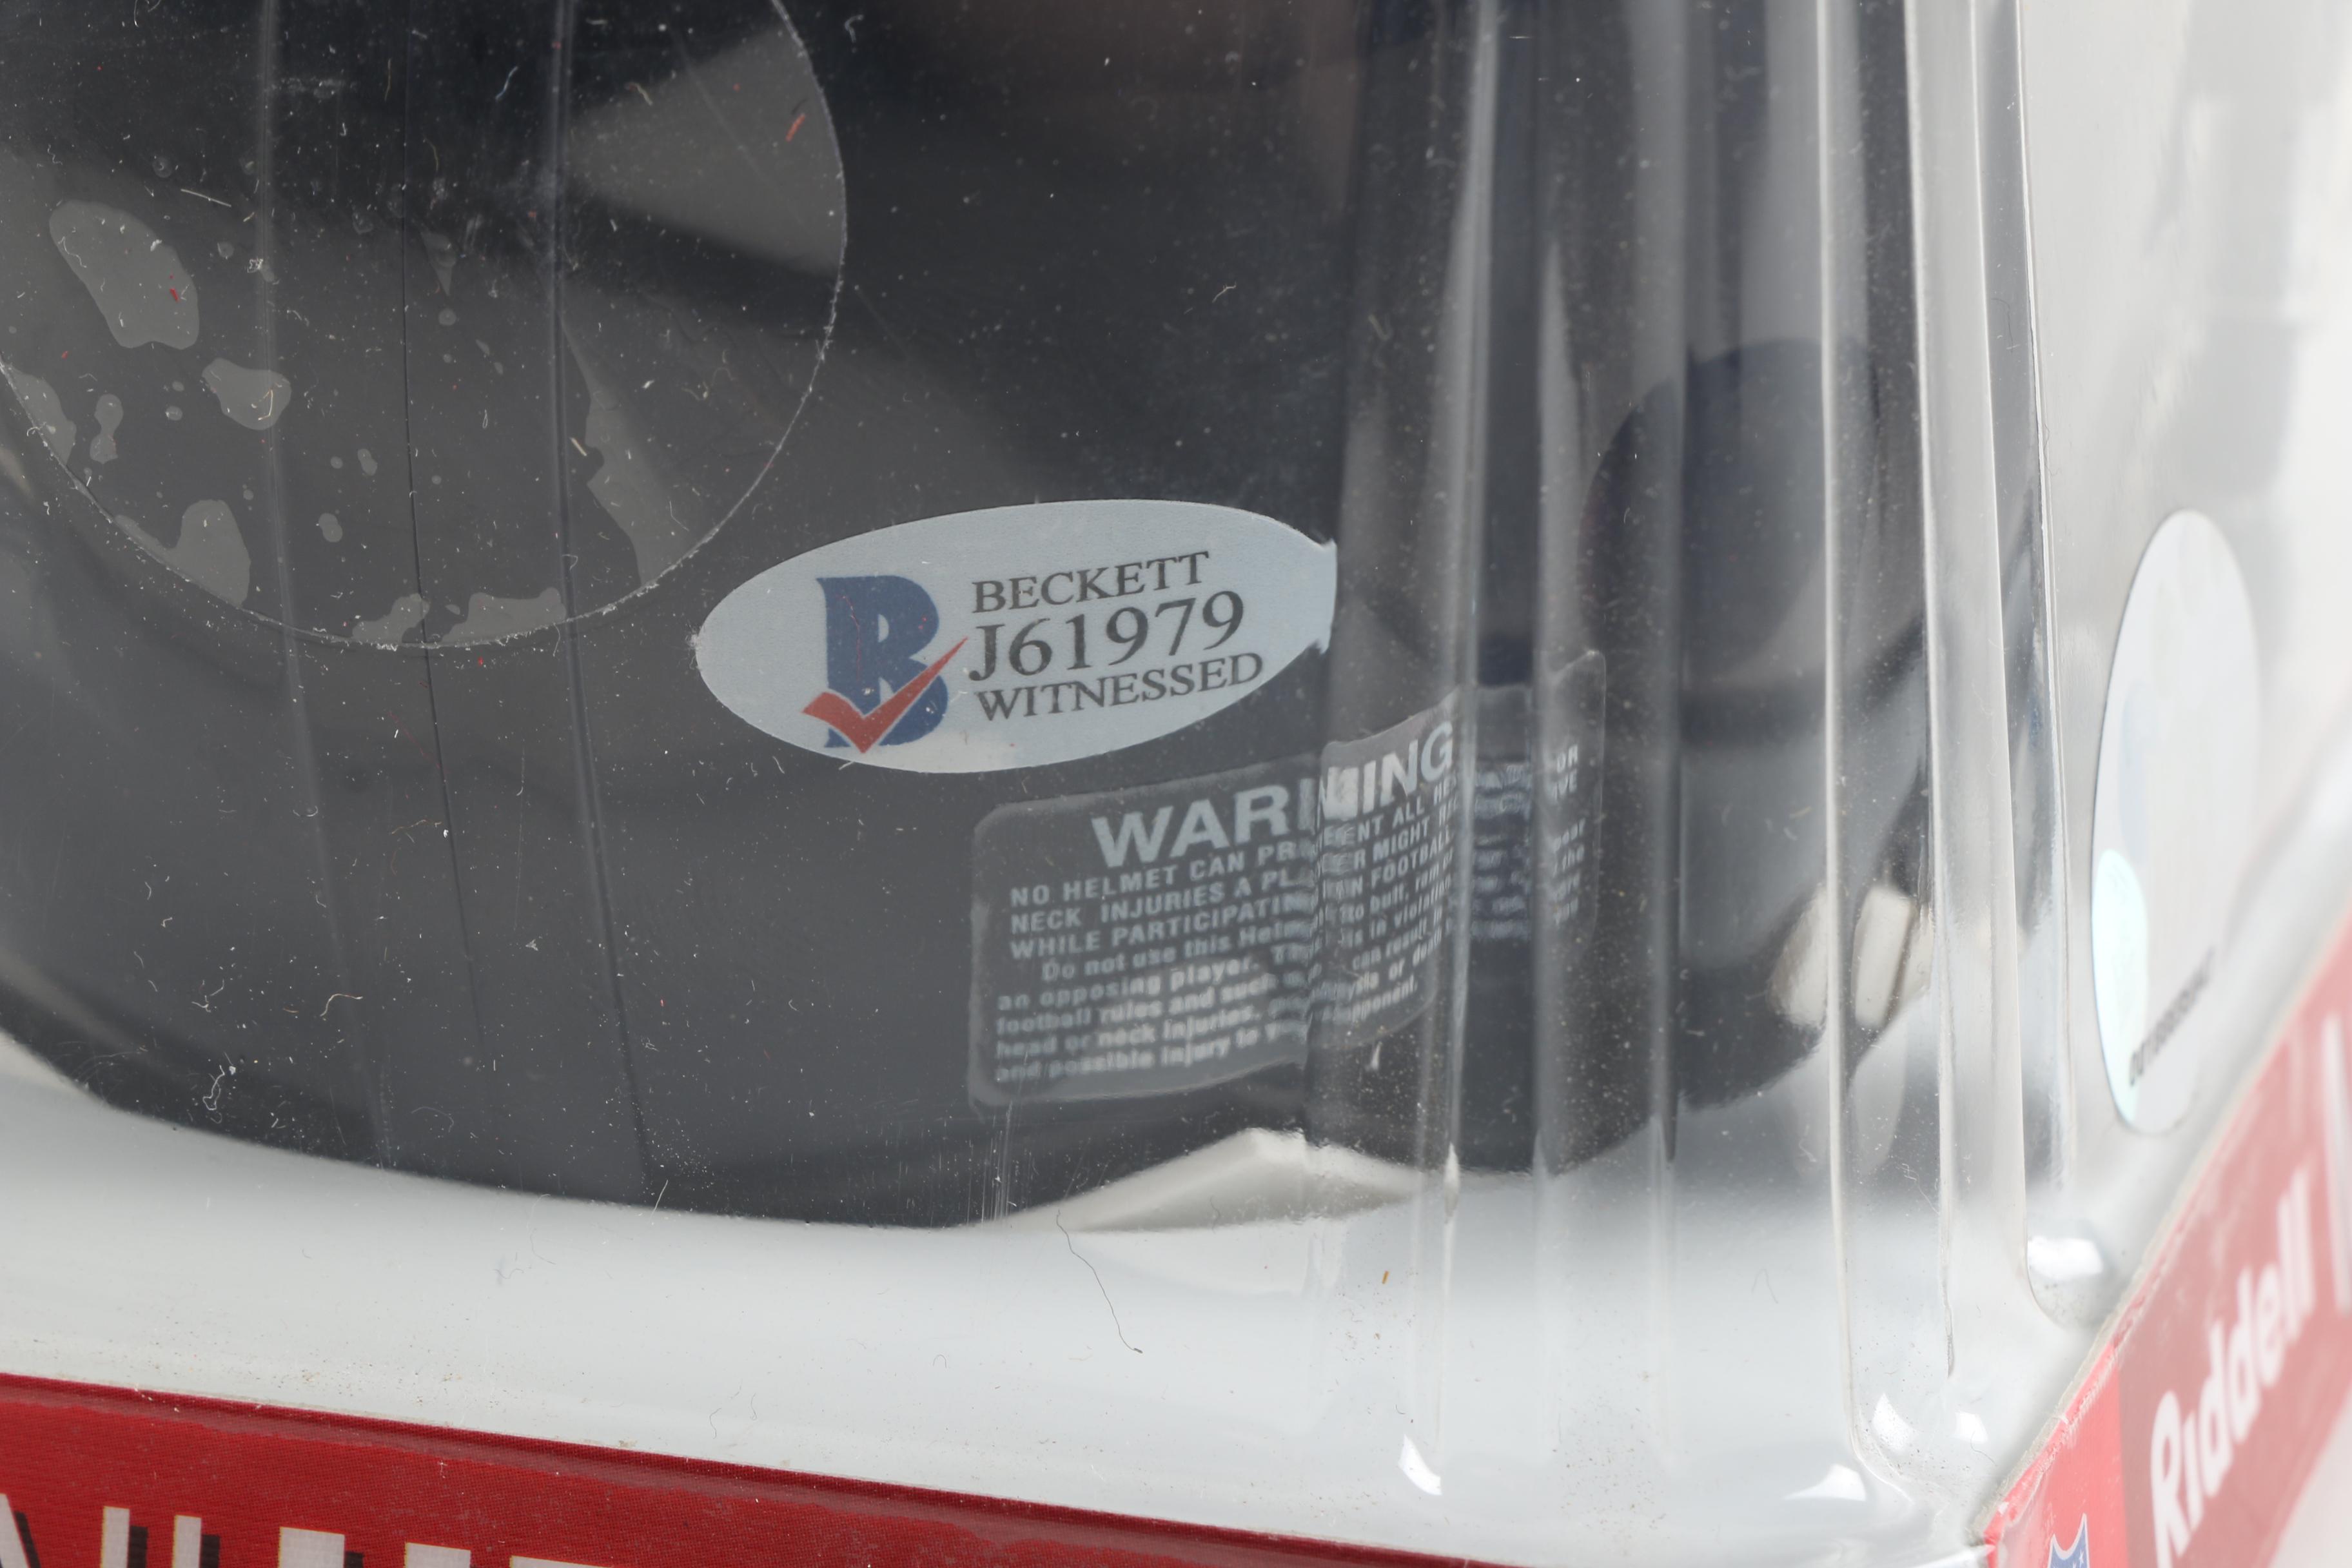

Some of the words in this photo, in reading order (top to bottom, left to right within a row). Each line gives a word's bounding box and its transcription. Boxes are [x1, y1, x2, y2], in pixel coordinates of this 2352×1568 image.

[972, 551, 1210, 613] BECKETT
[968, 590, 1245, 682] J61979
[975, 652, 1264, 721] WITNESSED
[1010, 884, 1050, 908] NO
[1063, 865, 1179, 902] HELMET
[1189, 850, 1246, 883] CAN
[1391, 796, 1425, 830] ALL
[1010, 907, 1082, 935] NECK
[1100, 881, 1226, 923] INJURIES
[1232, 876, 1253, 898] A
[1371, 815, 1431, 863] MIGHT
[1010, 930, 1101, 961] WHILE
[1112, 892, 1318, 947] PARTICIPATIN
[1041, 959, 1076, 982] Do
[1084, 952, 1126, 976] not
[1132, 946, 1177, 968] use
[1184, 936, 1231, 959] this
[997, 1006, 1092, 1033] football
[1099, 999, 1162, 1024] rules
[1168, 986, 1215, 1015] and
[999, 994, 1030, 1011] an
[1039, 975, 1161, 1008] opposing
[996, 1035, 1058, 1057] head
[1098, 1023, 1157, 1048] neck
[2150, 1161, 2317, 1568] Riddell
